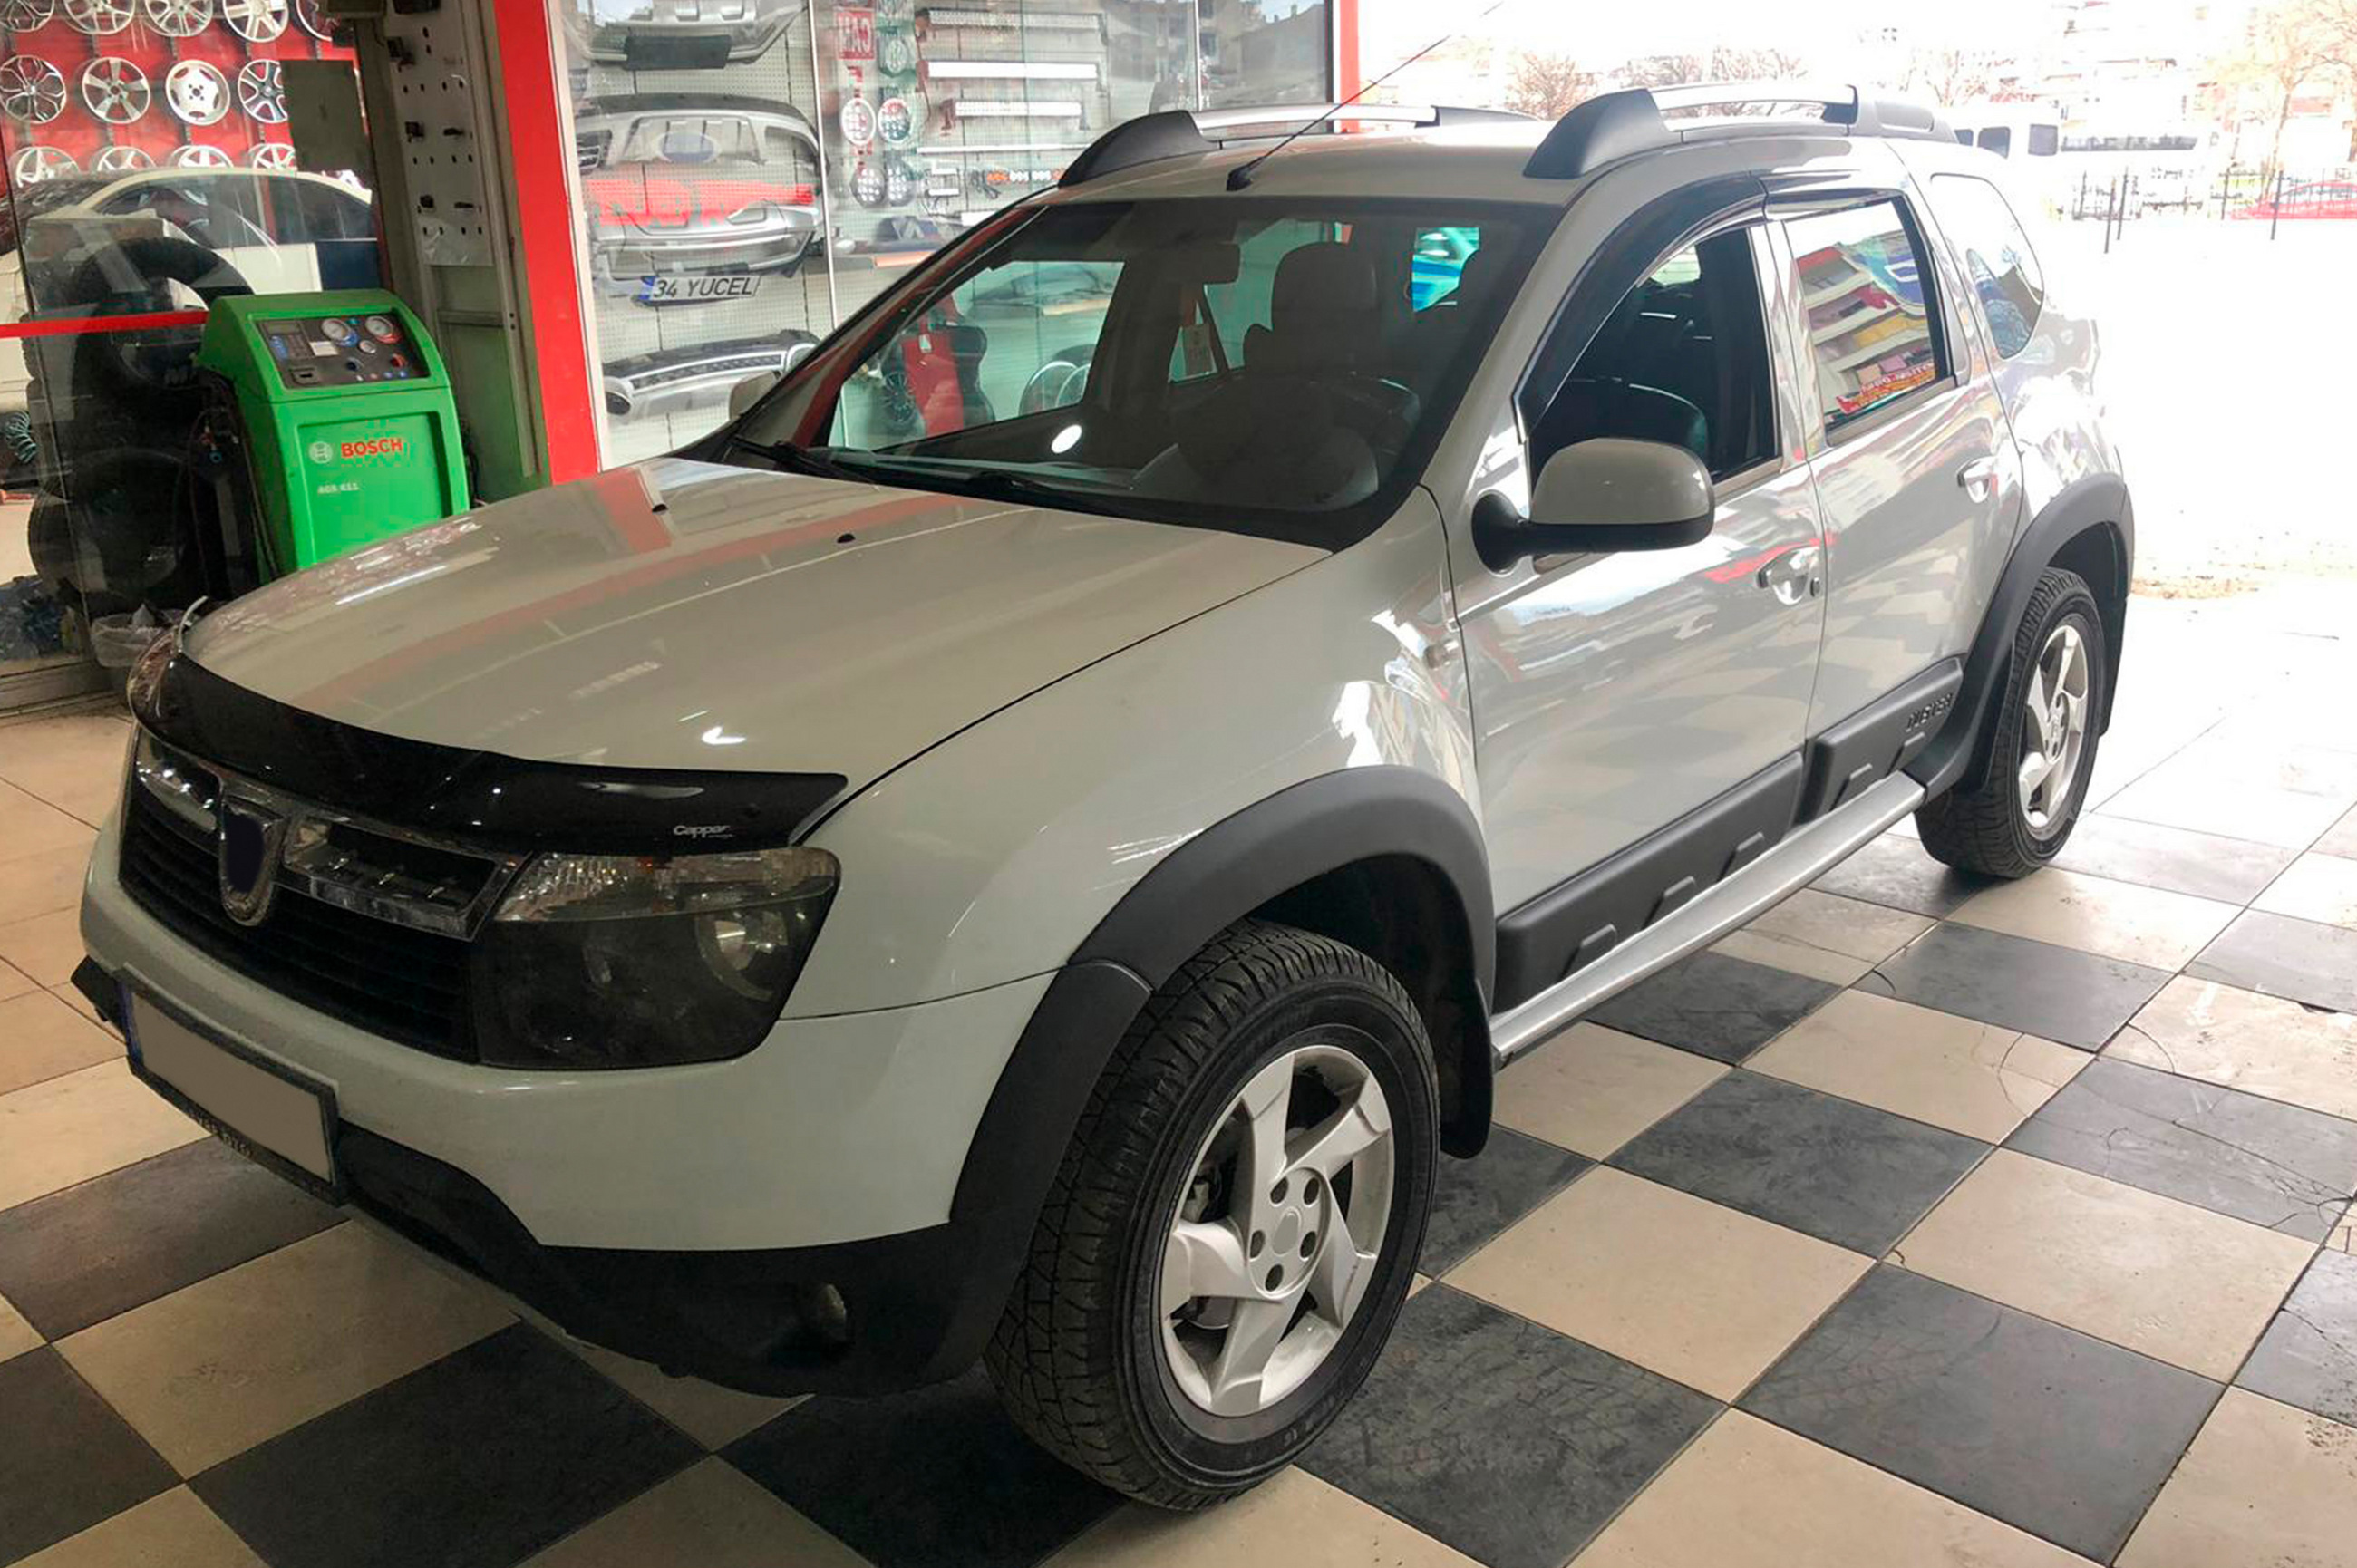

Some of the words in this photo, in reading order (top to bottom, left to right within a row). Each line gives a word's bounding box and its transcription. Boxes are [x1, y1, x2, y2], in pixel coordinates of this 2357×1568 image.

[653, 279, 677, 298] 34
[687, 276, 752, 297] YUCEL
[340, 437, 403, 459] BOSCH
